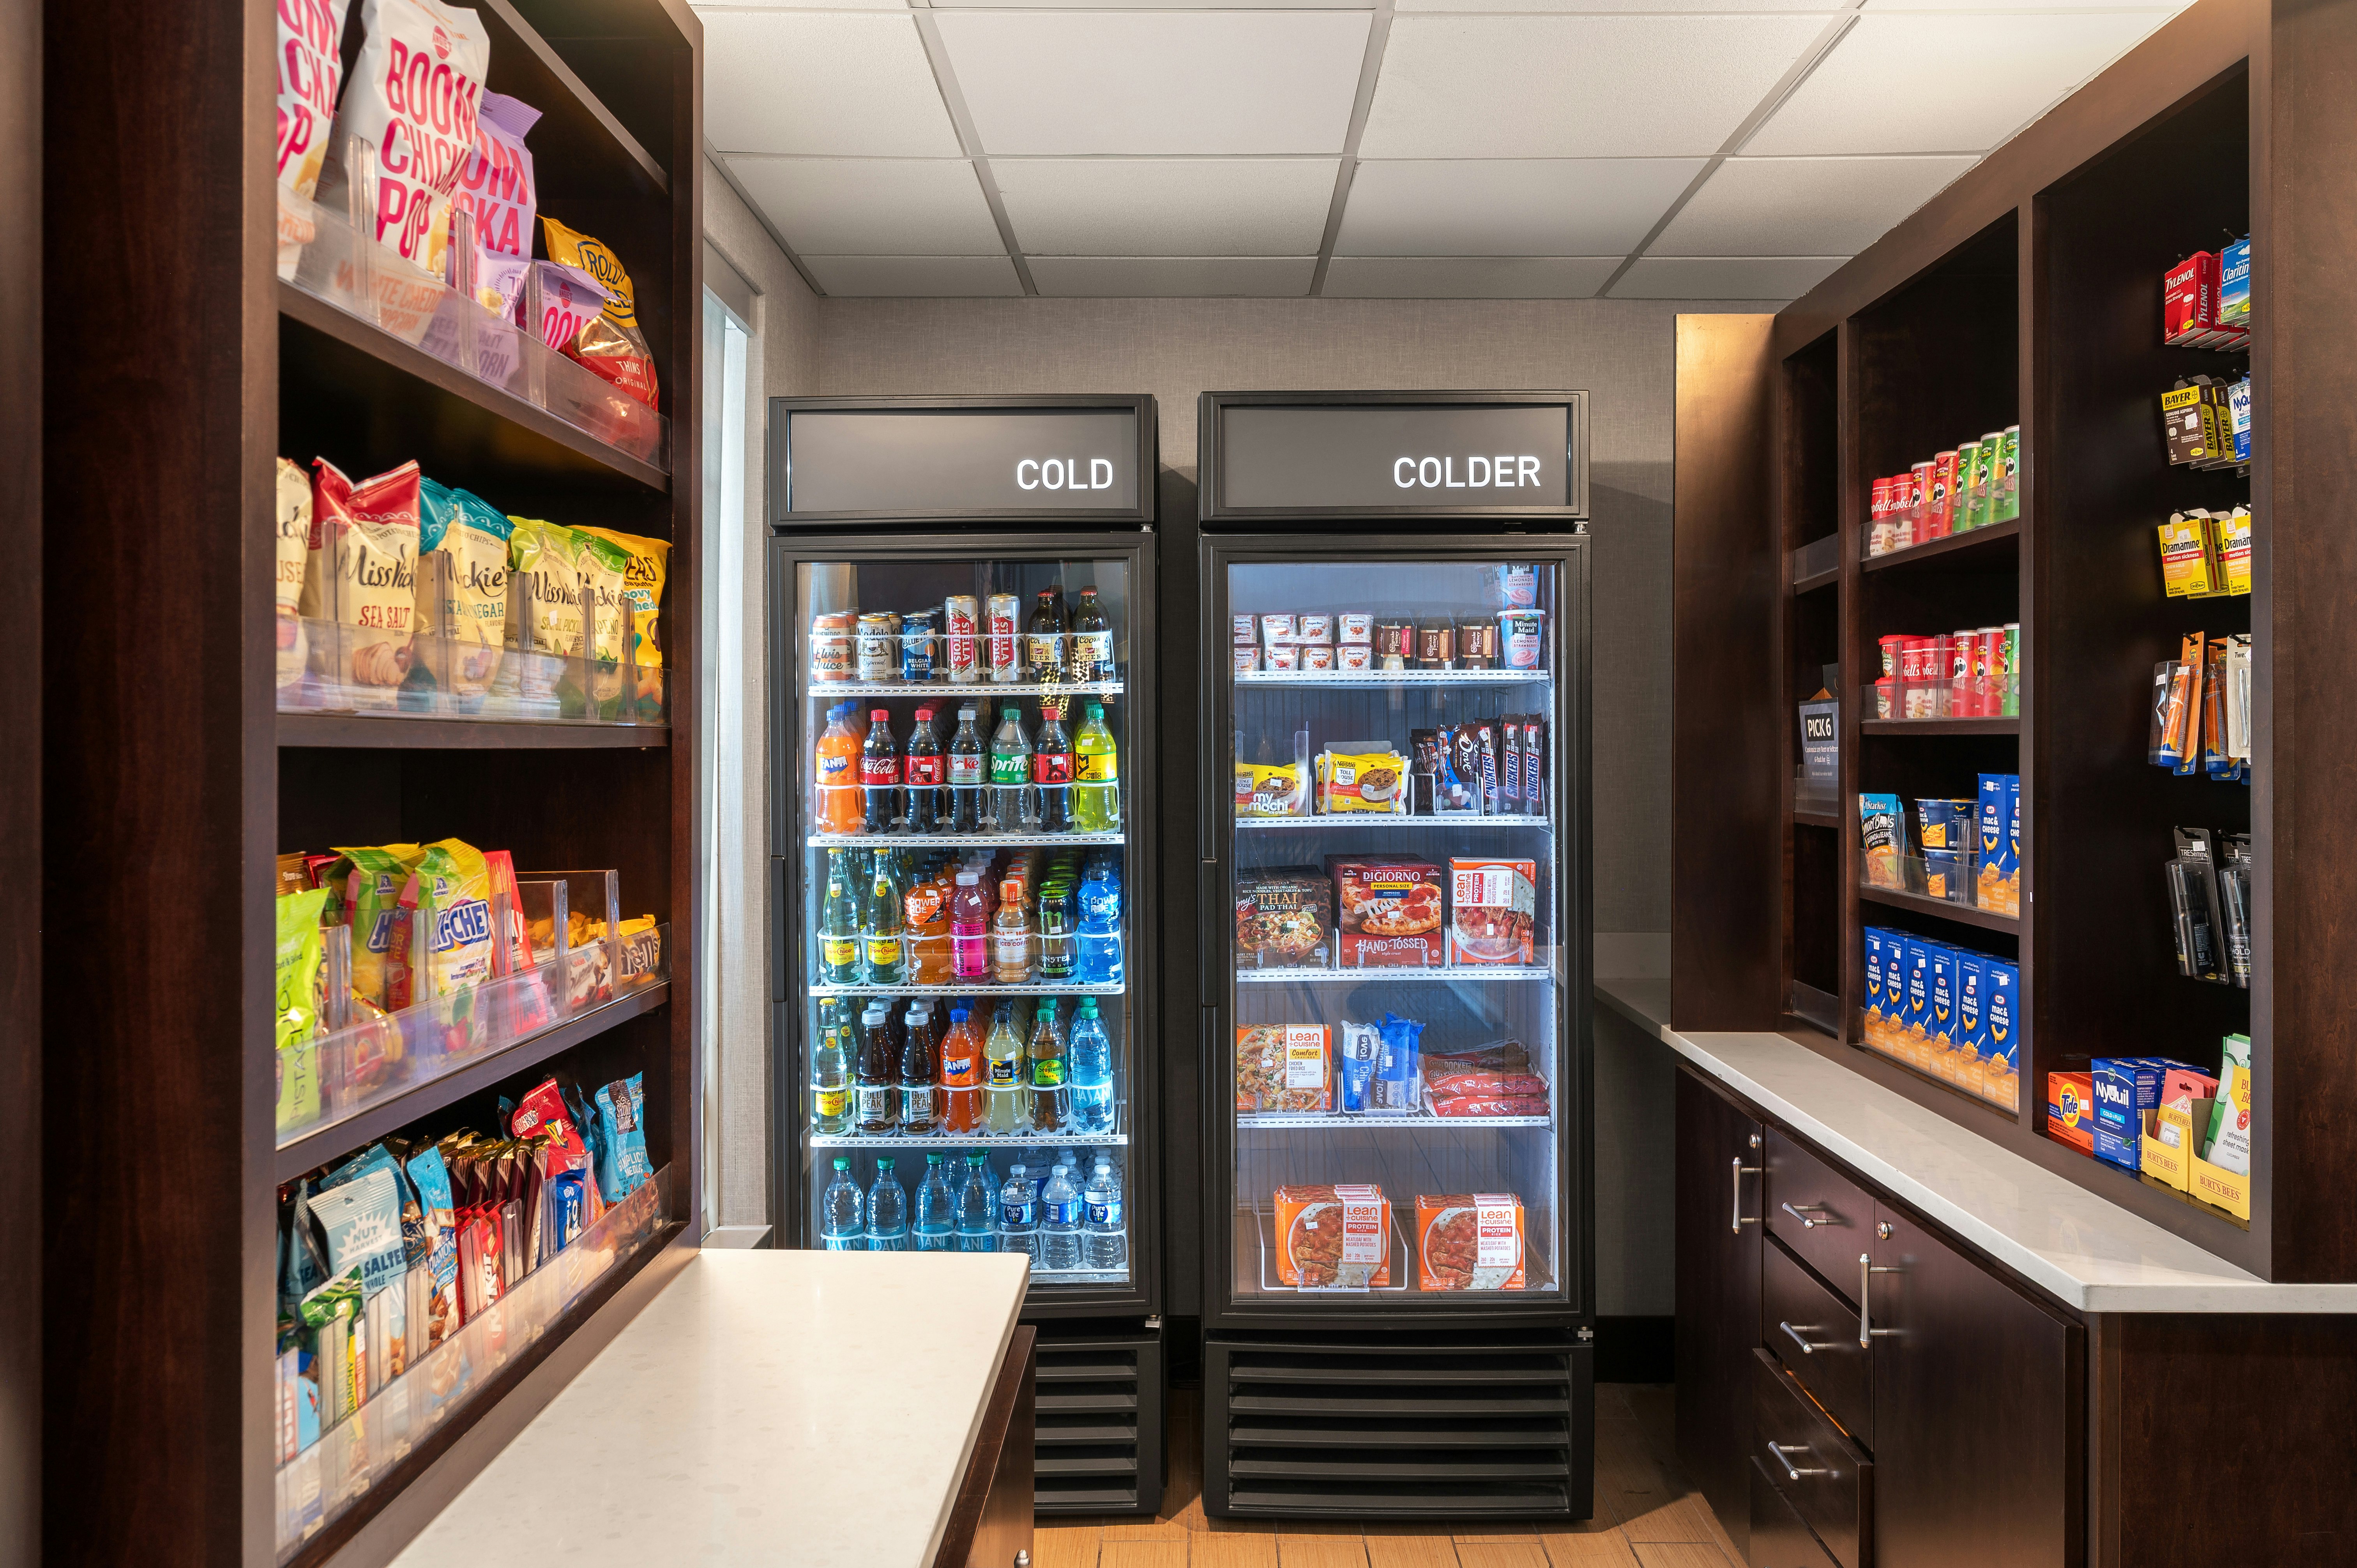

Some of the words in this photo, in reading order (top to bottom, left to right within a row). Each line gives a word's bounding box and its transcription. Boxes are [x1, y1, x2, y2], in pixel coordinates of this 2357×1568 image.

[387, 37, 477, 144] BOOM
[381, 117, 472, 198] CHICKA
[377, 177, 433, 260] POP
[2223, 263, 2249, 282] Claritin
[2165, 267, 2194, 293] TYLENOL
[559, 291, 572, 302] ANGIE'S
[2198, 283, 2208, 323] TYLENOL
[615, 361, 640, 375] THINS
[615, 376, 647, 390] ORIGINAL
[1017, 459, 1113, 489] COLD
[1394, 456, 1540, 487] COLDER
[470, 533, 490, 545] CHIPS
[2162, 540, 2199, 554] Dramamine
[359, 605, 383, 628] SEA
[387, 607, 410, 629] SALT
[816, 647, 842, 659] Elvis
[815, 661, 843, 670] Juice
[862, 659, 886, 667] Especial
[1808, 718, 1825, 737] PICK
[1826, 718, 1831, 736] 6
[860, 758, 897, 774] Coca-Cola
[1527, 755, 1539, 800] SNICKERS
[1253, 793, 1274, 804] my
[1249, 801, 1288, 811] mochi
[1983, 816, 1993, 825] mac
[1993, 816, 1998, 825] &
[1982, 825, 1999, 834] cheese
[2180, 849, 2208, 857] TRESemmé
[1457, 874, 1465, 903] Lean
[1257, 893, 1298, 904] THAI
[869, 945, 881, 954] Topo
[881, 946, 897, 955] Chico
[1868, 972, 1881, 982] cheese
[1911, 979, 1919, 988] mac
[1920, 981, 1924, 989] &
[1910, 987, 1925, 998] cheese
[1963, 996, 1972, 1005] mac
[1973, 998, 1977, 1006] &
[1961, 1004, 1979, 1015] cheese
[1991, 1005, 2002, 1014] mac
[2003, 1007, 2008, 1017] &
[1990, 1013, 2009, 1026] cheese
[1038, 1065, 1063, 1073] Seagram's
[832, 1095, 845, 1105] Chico
[862, 1099, 882, 1108] PEAK
[912, 1099, 931, 1108] PEAK
[2062, 1094, 2078, 1116] Tide
[617, 1102, 631, 1117] SECOND
[515, 1120, 527, 1133] BIG
[524, 1111, 538, 1127] BAG
[618, 1116, 633, 1130] NATURE
[2169, 1113, 2182, 1123] BURT'S
[2182, 1118, 2191, 1127] BEES
[2227, 1132, 2249, 1146] refreshing
[2223, 1139, 2235, 1149] sheet
[2235, 1145, 2249, 1154] mask
[2147, 1151, 2163, 1165] BURT'S
[2164, 1159, 2177, 1171] BEES
[2200, 1175, 2221, 1192] BURT'S
[2223, 1187, 2239, 1200] BEES
[1347, 1207, 1377, 1215] Lean
[353, 1226, 377, 1243] NUT
[350, 1235, 383, 1254] HARVEST
[364, 1275, 385, 1291] WHOLE
